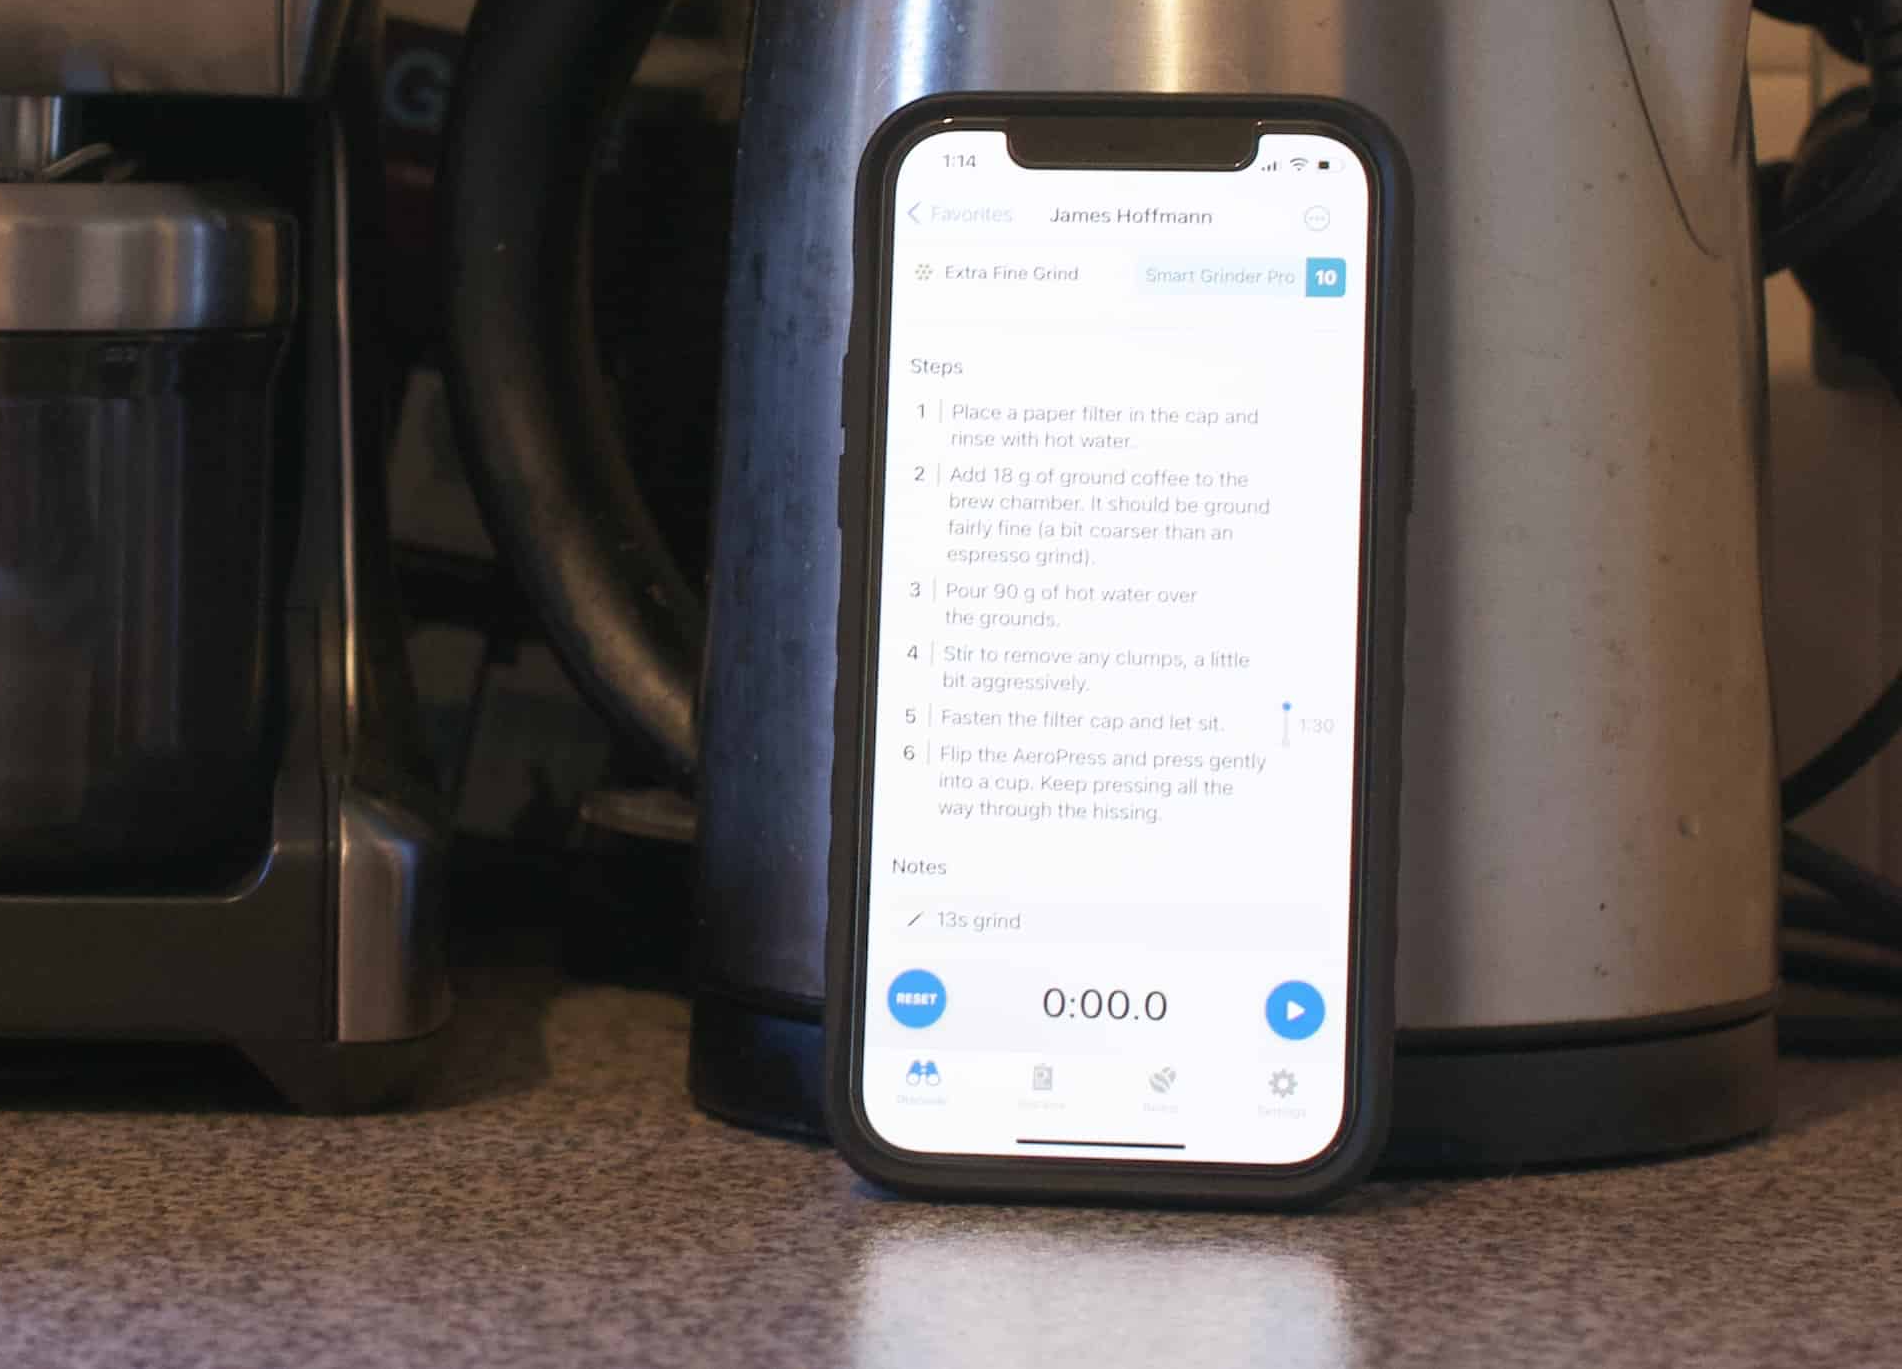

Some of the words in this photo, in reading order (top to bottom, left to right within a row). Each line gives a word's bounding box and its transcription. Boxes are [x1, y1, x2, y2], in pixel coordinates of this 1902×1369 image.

[942, 154, 978, 168] 1:14
[930, 205, 1013, 223] Favorites
[1050, 207, 1111, 226] James
[1117, 208, 1213, 226] Hoffmann
[944, 265, 988, 281] Extra
[993, 265, 1027, 281] Fine
[1032, 265, 1079, 281] Grind
[1146, 267, 1195, 284] Smart
[1200, 268, 1263, 285] Grinder
[1267, 269, 1295, 285] Pro
[1315, 270, 1337, 286] 10
[910, 358, 963, 378] Steps
[917, 404, 926, 420] 1
[952, 404, 1002, 421] Place
[1006, 408, 1018, 421] a
[1023, 406, 1075, 425] paper
[1081, 406, 1122, 422] filter
[1129, 407, 1146, 423] in
[1150, 407, 1179, 423] the
[1185, 411, 1219, 427] cap
[1224, 408, 1259, 425] and
[951, 430, 995, 448] rinse
[1001, 432, 1039, 448] with
[1044, 431, 1074, 448] hot
[913, 467, 925, 482] 2
[950, 467, 986, 484] Add
[993, 468, 1013, 485] 18
[1018, 473, 1031, 489] g
[1035, 469, 1054, 486] of
[1060, 469, 1125, 489] ground
[1131, 470, 1190, 487] coffee
[1195, 472, 1213, 488] to
[1220, 471, 1249, 488] the
[948, 494, 993, 510] brew
[1090, 497, 1103, 513] It
[1108, 496, 1170, 514] should
[1176, 498, 1199, 514] be
[1204, 498, 1270, 517] ground
[948, 520, 993, 539] fairly
[998, 521, 1032, 537] fine
[1038, 521, 1056, 540] (a
[1060, 523, 1083, 538] bit
[1089, 524, 1159, 540] coarser
[1165, 524, 1206, 541] than
[1211, 528, 1234, 541] an
[946, 548, 1030, 567] espresso
[910, 582, 921, 598] 3
[946, 582, 986, 600] Pour
[994, 583, 1018, 600] 90
[1023, 588, 1035, 605] g
[1040, 584, 1061, 601] of
[1065, 585, 1095, 602] hot
[1100, 587, 1153, 603] water
[1157, 589, 1198, 604] over
[945, 610, 975, 626] the
[906, 645, 918, 661] 4
[943, 646, 972, 663] Stir
[980, 647, 998, 663] to
[1003, 651, 1072, 664] remove
[1078, 652, 1110, 668] any
[1194, 655, 1205, 668] a
[1210, 651, 1250, 669] little
[942, 673, 966, 690] bit
[904, 709, 917, 725] 5
[941, 710, 1002, 726] Fasten
[1008, 711, 1037, 727] the
[1042, 711, 1083, 729] filter
[1090, 717, 1124, 732] cap
[1129, 713, 1163, 730] and
[1169, 714, 1192, 731] let
[1198, 715, 1225, 732] sit.
[903, 746, 915, 761] 6
[940, 746, 972, 765] Flip
[978, 747, 1007, 763] the
[1012, 748, 1107, 768] AeroPress
[1112, 750, 1147, 767] and
[1153, 754, 1203, 771] press
[1209, 752, 1266, 773] gently
[938, 774, 972, 790] into
[978, 778, 989, 790] a
[995, 778, 1035, 795] cup.
[1040, 776, 1088, 795] Keep
[1092, 778, 1172, 797] pressing
[1177, 778, 1199, 796] all
[1203, 779, 1233, 796] the
[938, 803, 973, 819] way
[979, 800, 1052, 820] through
[1058, 802, 1087, 818] the
[892, 858, 947, 876] Notes
[937, 912, 968, 929] 13s
[973, 913, 1021, 932] grind
[895, 992, 938, 1006] RESET
[1042, 988, 1168, 1022] 0:00.0
